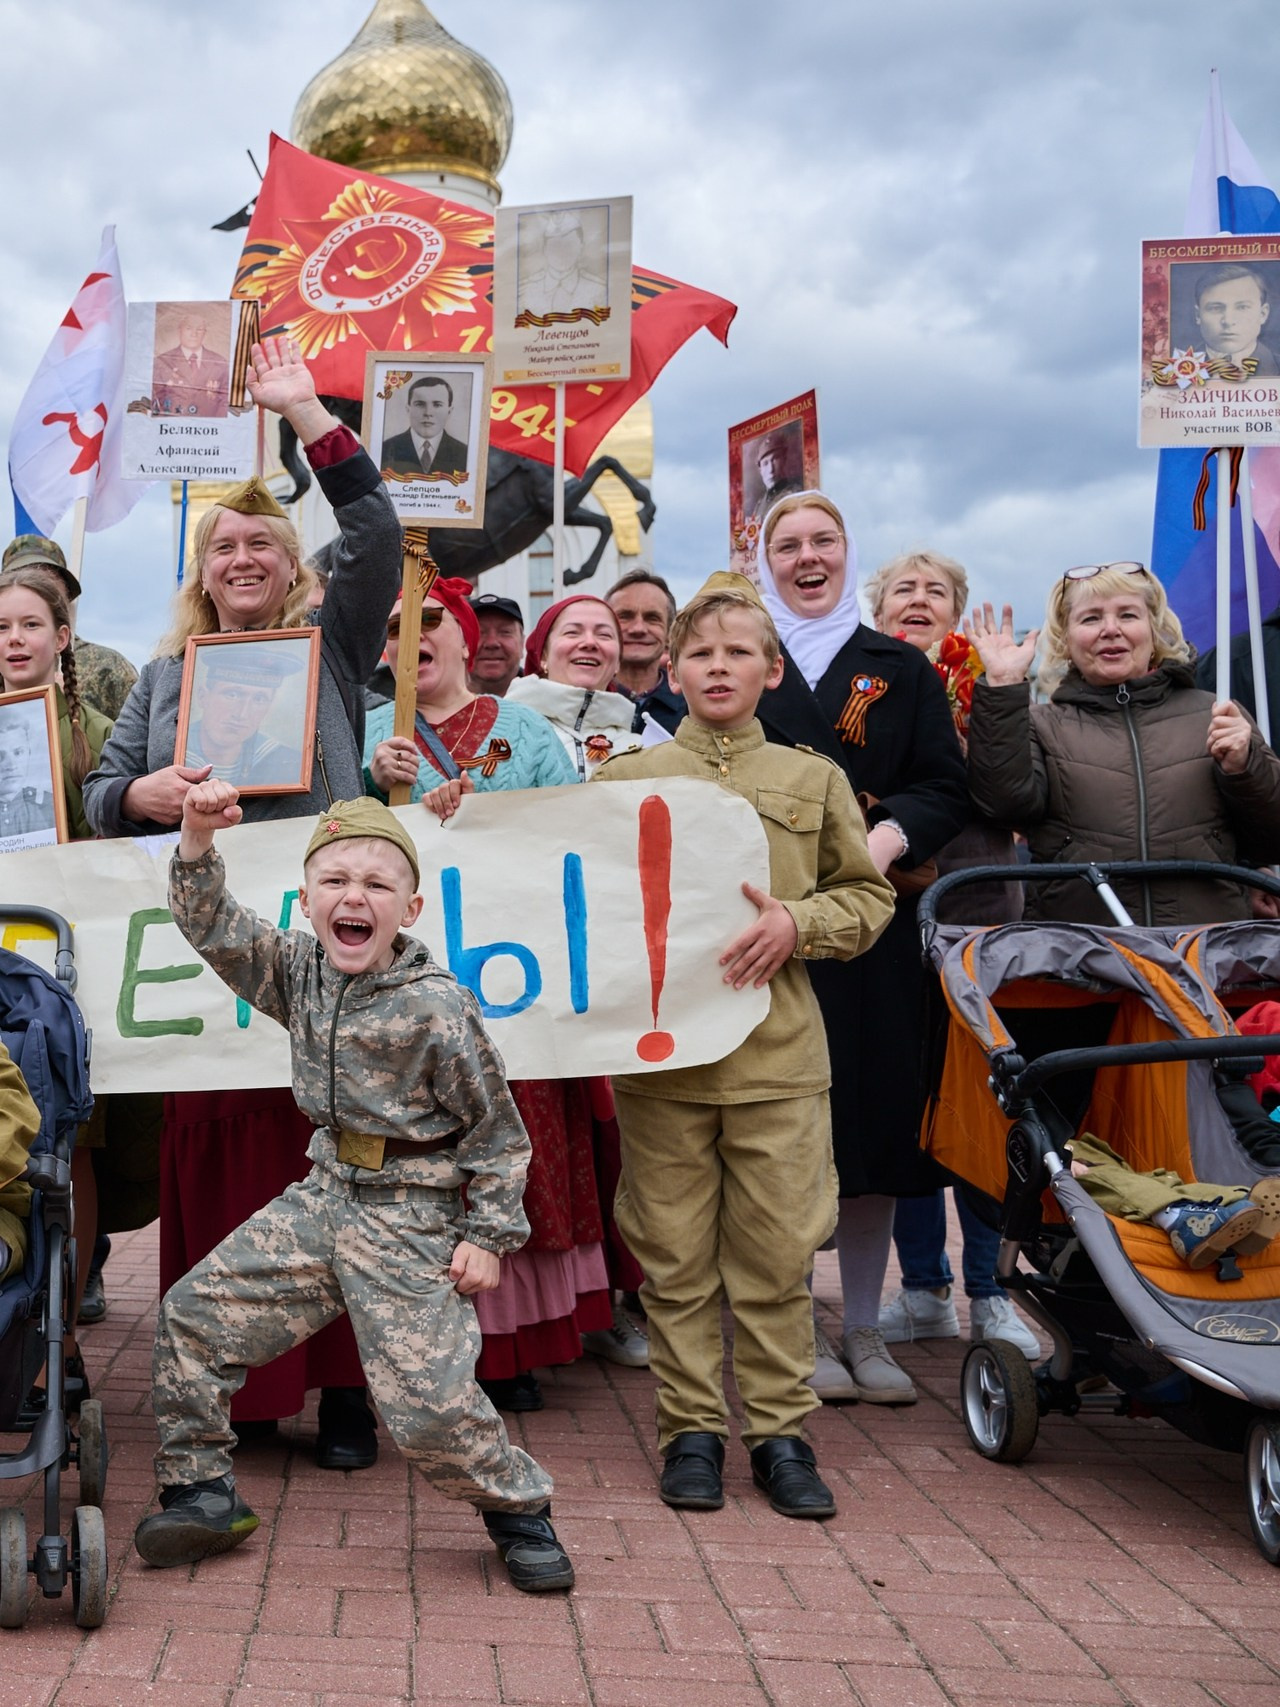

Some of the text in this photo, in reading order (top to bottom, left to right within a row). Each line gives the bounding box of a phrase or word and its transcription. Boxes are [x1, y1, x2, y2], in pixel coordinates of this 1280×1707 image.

[1148, 242, 1263, 258] БЕССМЕРТНЫЙ
[306, 215, 440, 300] ОТЕЧЕСТВЕННАЯ
[1178, 388, 1278, 404] ЗАЙЧИКОВ
[731, 397, 814, 442] БЕССМЕРТНЫЙ ПОЛК
[1160, 406, 1216, 419] Николай
[159, 423, 218, 436] Беляков
[1184, 422, 1273, 437] участник ВОВ
[155, 445, 220, 458] Афанасий
[137, 464, 237, 476] Александрович
[402, 485, 441, 493] Слепцов
